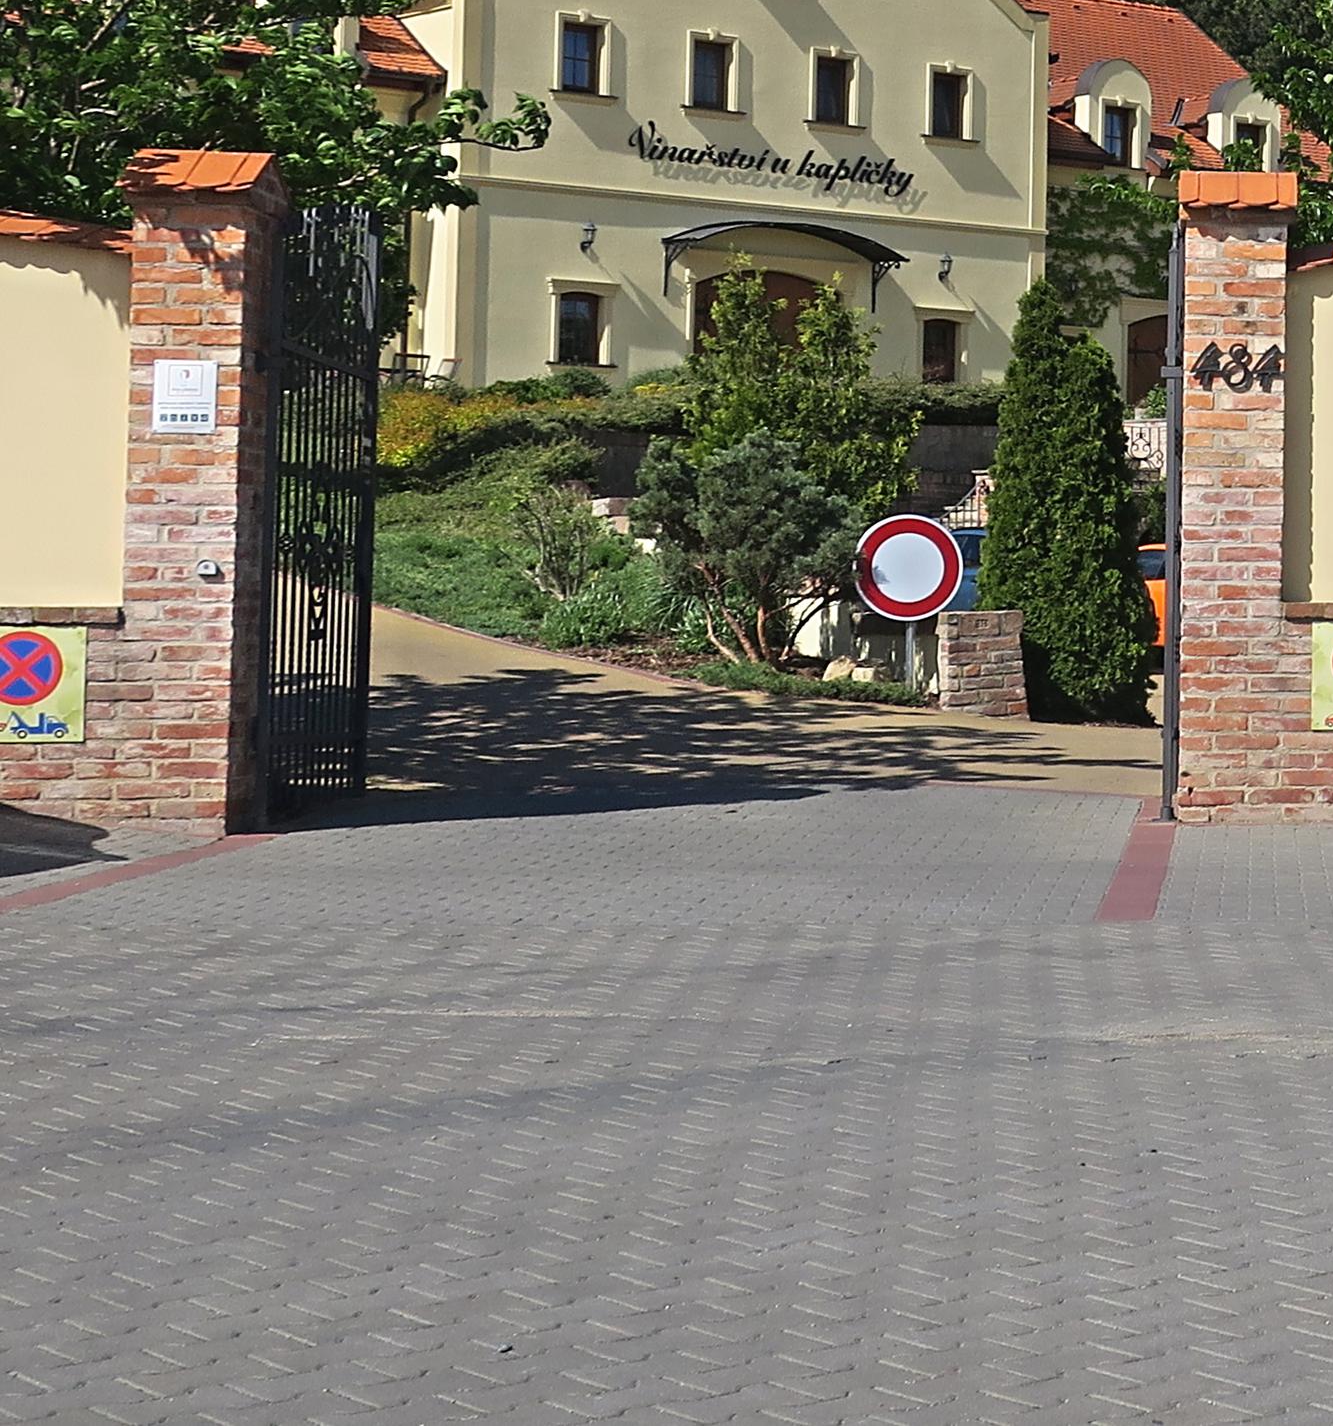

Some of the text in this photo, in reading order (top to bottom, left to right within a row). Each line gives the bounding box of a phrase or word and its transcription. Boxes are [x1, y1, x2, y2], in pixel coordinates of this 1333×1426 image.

[628, 120, 915, 197] Vinařství u kapličky
[1190, 341, 1285, 394] 484
